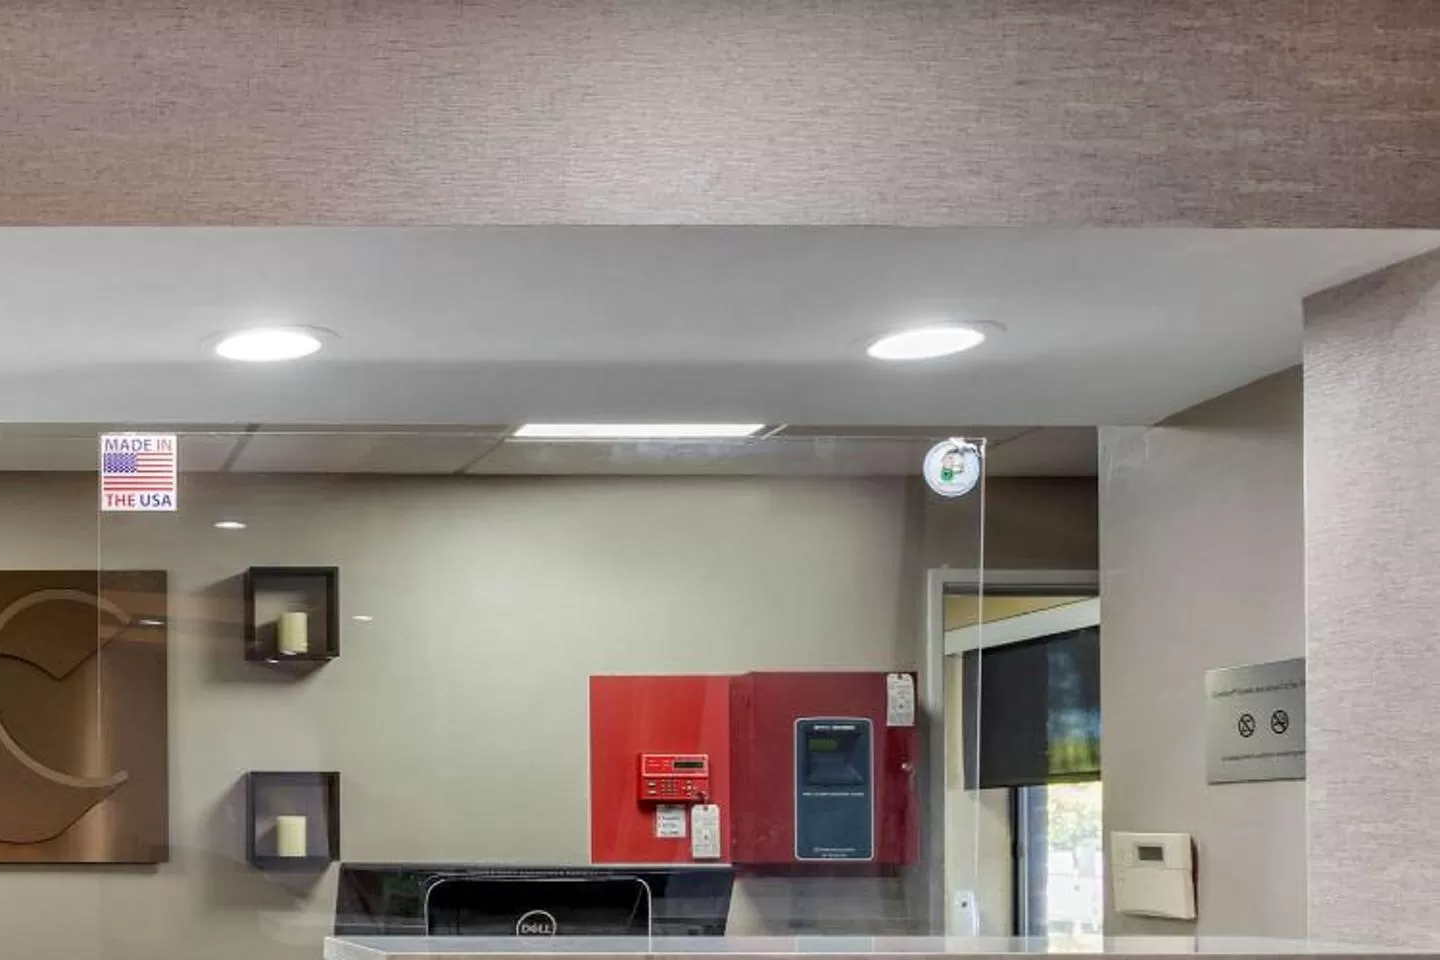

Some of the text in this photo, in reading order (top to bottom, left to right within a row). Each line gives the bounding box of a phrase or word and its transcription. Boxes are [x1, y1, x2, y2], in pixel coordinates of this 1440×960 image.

[105, 438, 172, 451] MADE IN
[105, 494, 172, 507] THE USA
[521, 923, 553, 934] DELL
